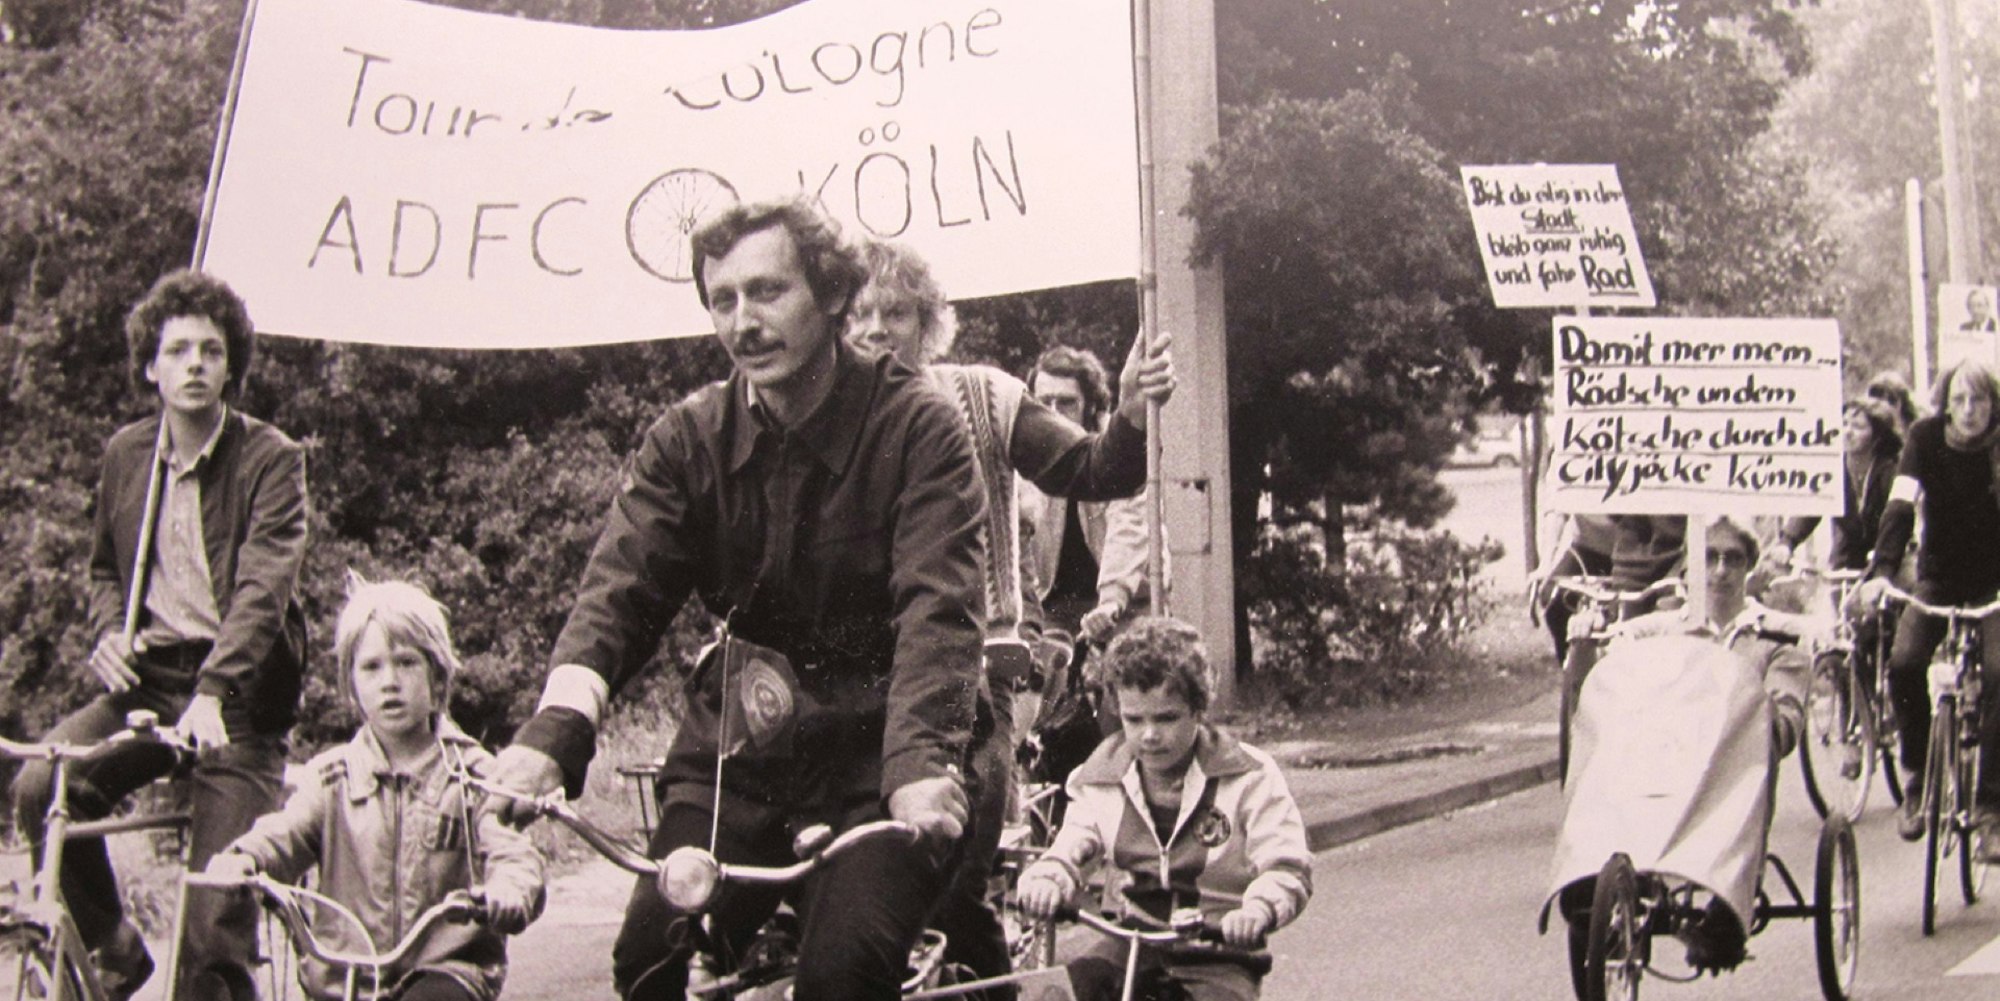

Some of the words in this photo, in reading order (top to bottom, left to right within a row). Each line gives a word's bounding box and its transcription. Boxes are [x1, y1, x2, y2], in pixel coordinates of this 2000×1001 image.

[342, 46, 502, 137] Tour
[307, 195, 587, 280] ADFC
[797, 120, 1027, 238] KÖLN
[1469, 176, 1505, 206] Bist
[1509, 183, 1531, 205] du
[1487, 232, 1530, 257] bleib
[1533, 237, 1571, 254] ganz
[1579, 225, 1626, 255] ruhig
[1494, 261, 1531, 284] und
[1579, 255, 1636, 293] Rad
[1559, 325, 1654, 364] Damit
[1662, 340, 1725, 362] mer
[1566, 366, 1690, 407] Rädsche
[1709, 416, 1797, 450] durch
[1801, 417, 1840, 447] de
[1558, 451, 1629, 503] City
